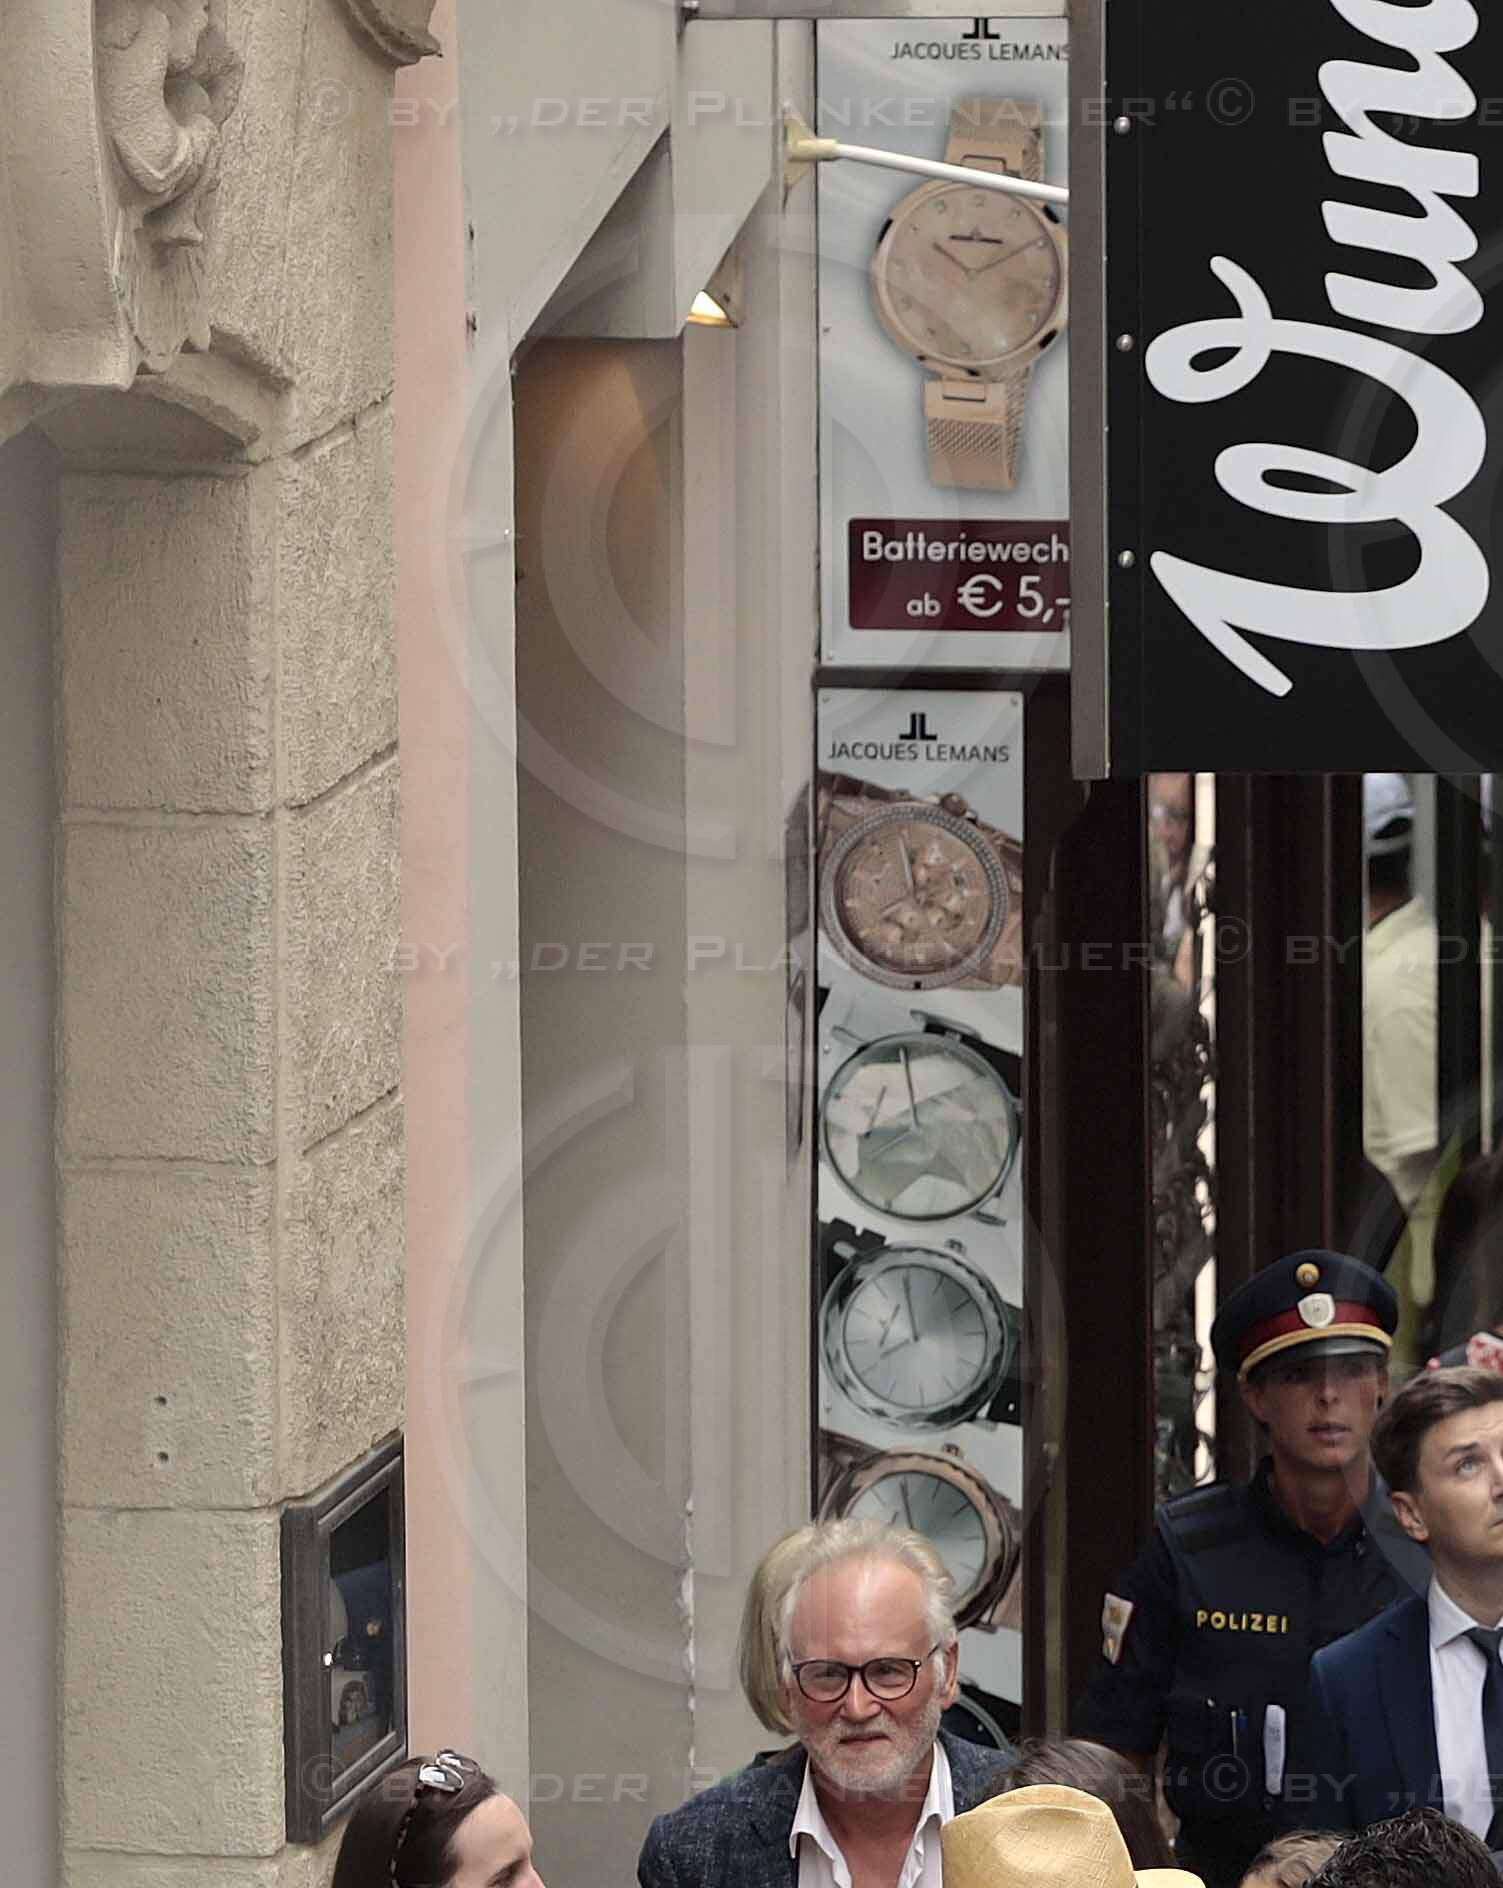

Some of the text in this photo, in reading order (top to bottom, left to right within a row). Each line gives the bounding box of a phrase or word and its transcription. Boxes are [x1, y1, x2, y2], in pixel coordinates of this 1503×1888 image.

[890, 41, 982, 61] JACQUES
[906, 593, 942, 617] ab
[957, 573, 1004, 618] €
[828, 742, 1010, 763] JACQUES LEMANS
[1196, 1609, 1289, 1634] POLIZEI
